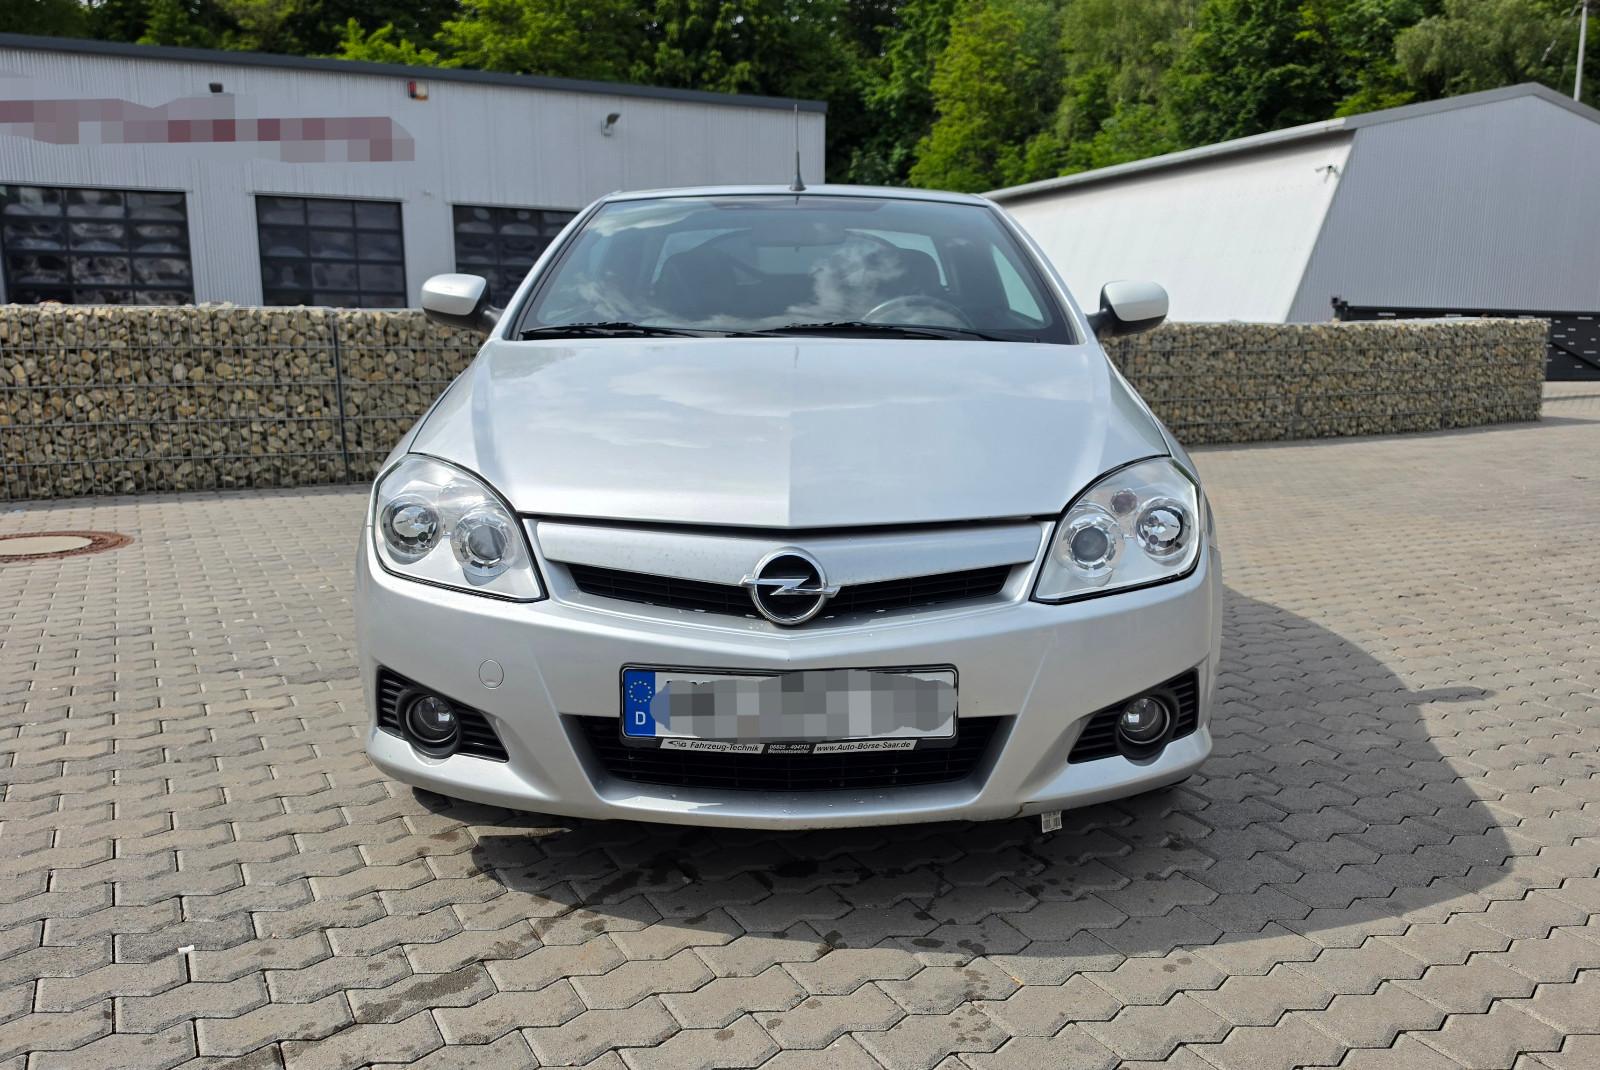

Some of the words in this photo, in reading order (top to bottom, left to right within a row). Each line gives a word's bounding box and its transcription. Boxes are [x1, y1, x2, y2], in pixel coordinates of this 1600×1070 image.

[635, 711, 646, 725] D
[690, 741, 759, 752] Fahrzeug-Technik
[816, 741, 911, 752] www.Auto-Börse-Saar.de
